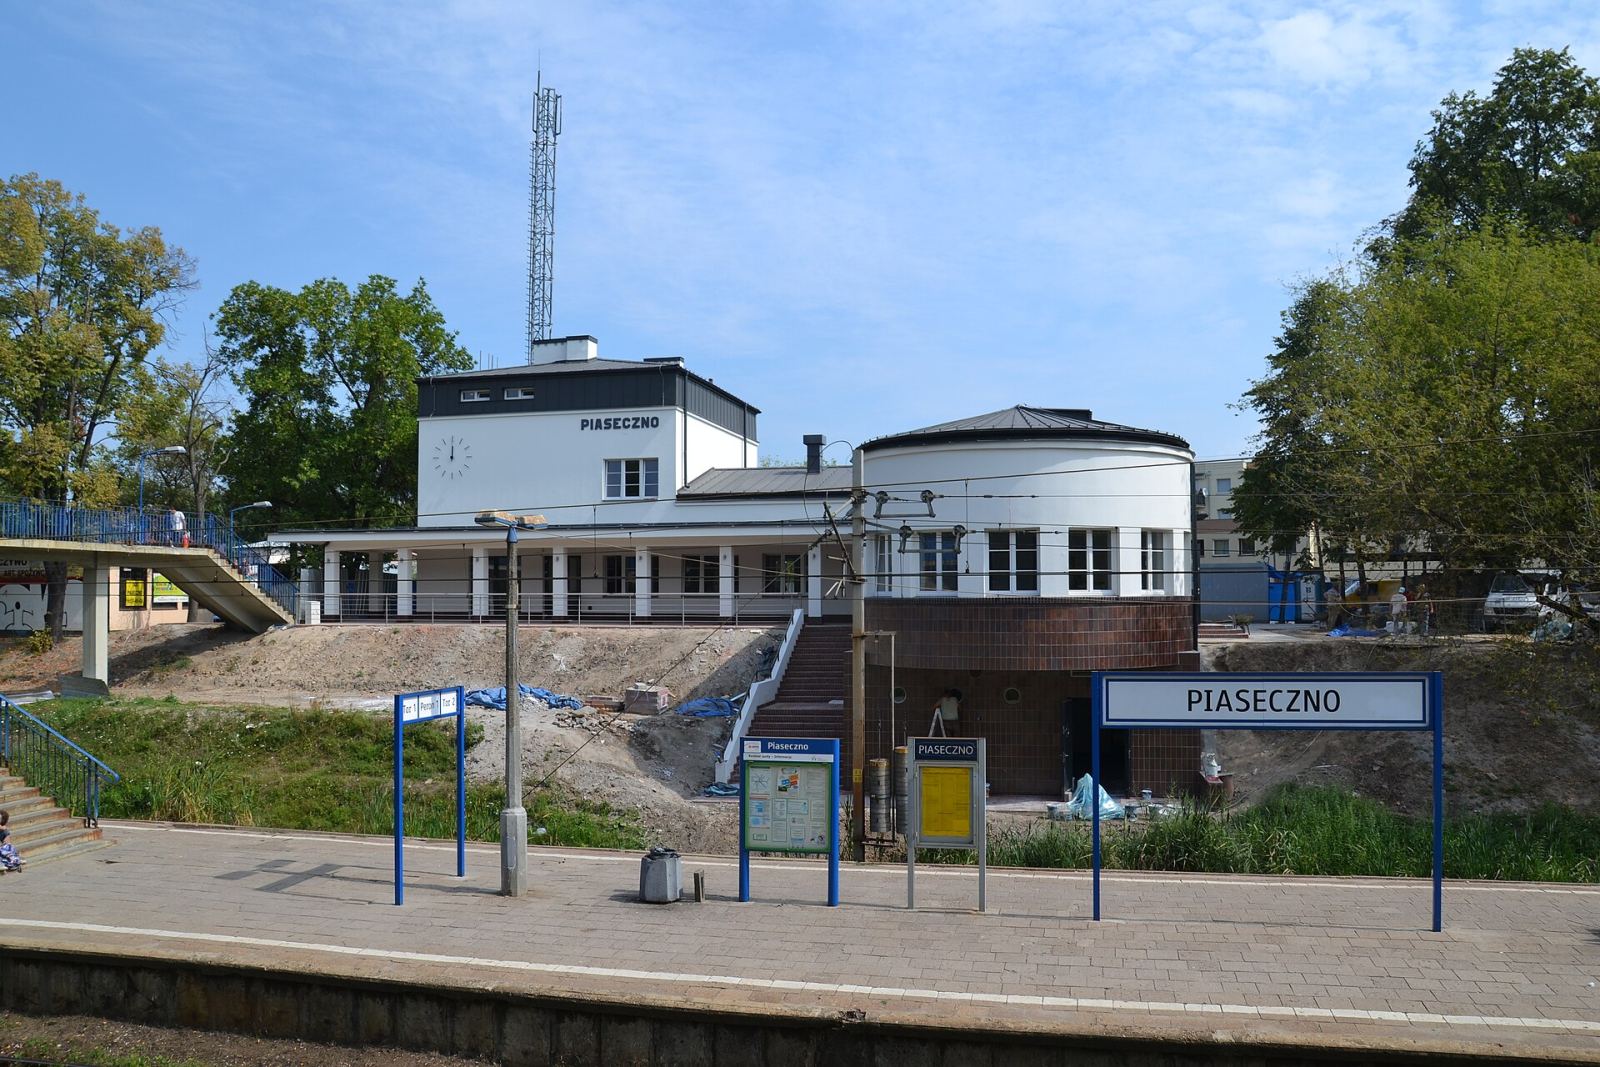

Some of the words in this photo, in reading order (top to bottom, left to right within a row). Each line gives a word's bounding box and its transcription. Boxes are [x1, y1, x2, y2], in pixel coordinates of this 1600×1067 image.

[580, 416, 660, 431] PIASECZNO
[420, 702, 435, 711] Peron
[1186, 689, 1341, 713] PIASECZNO
[767, 741, 809, 750] Piaseczno
[918, 744, 974, 755] PIASECZNO
